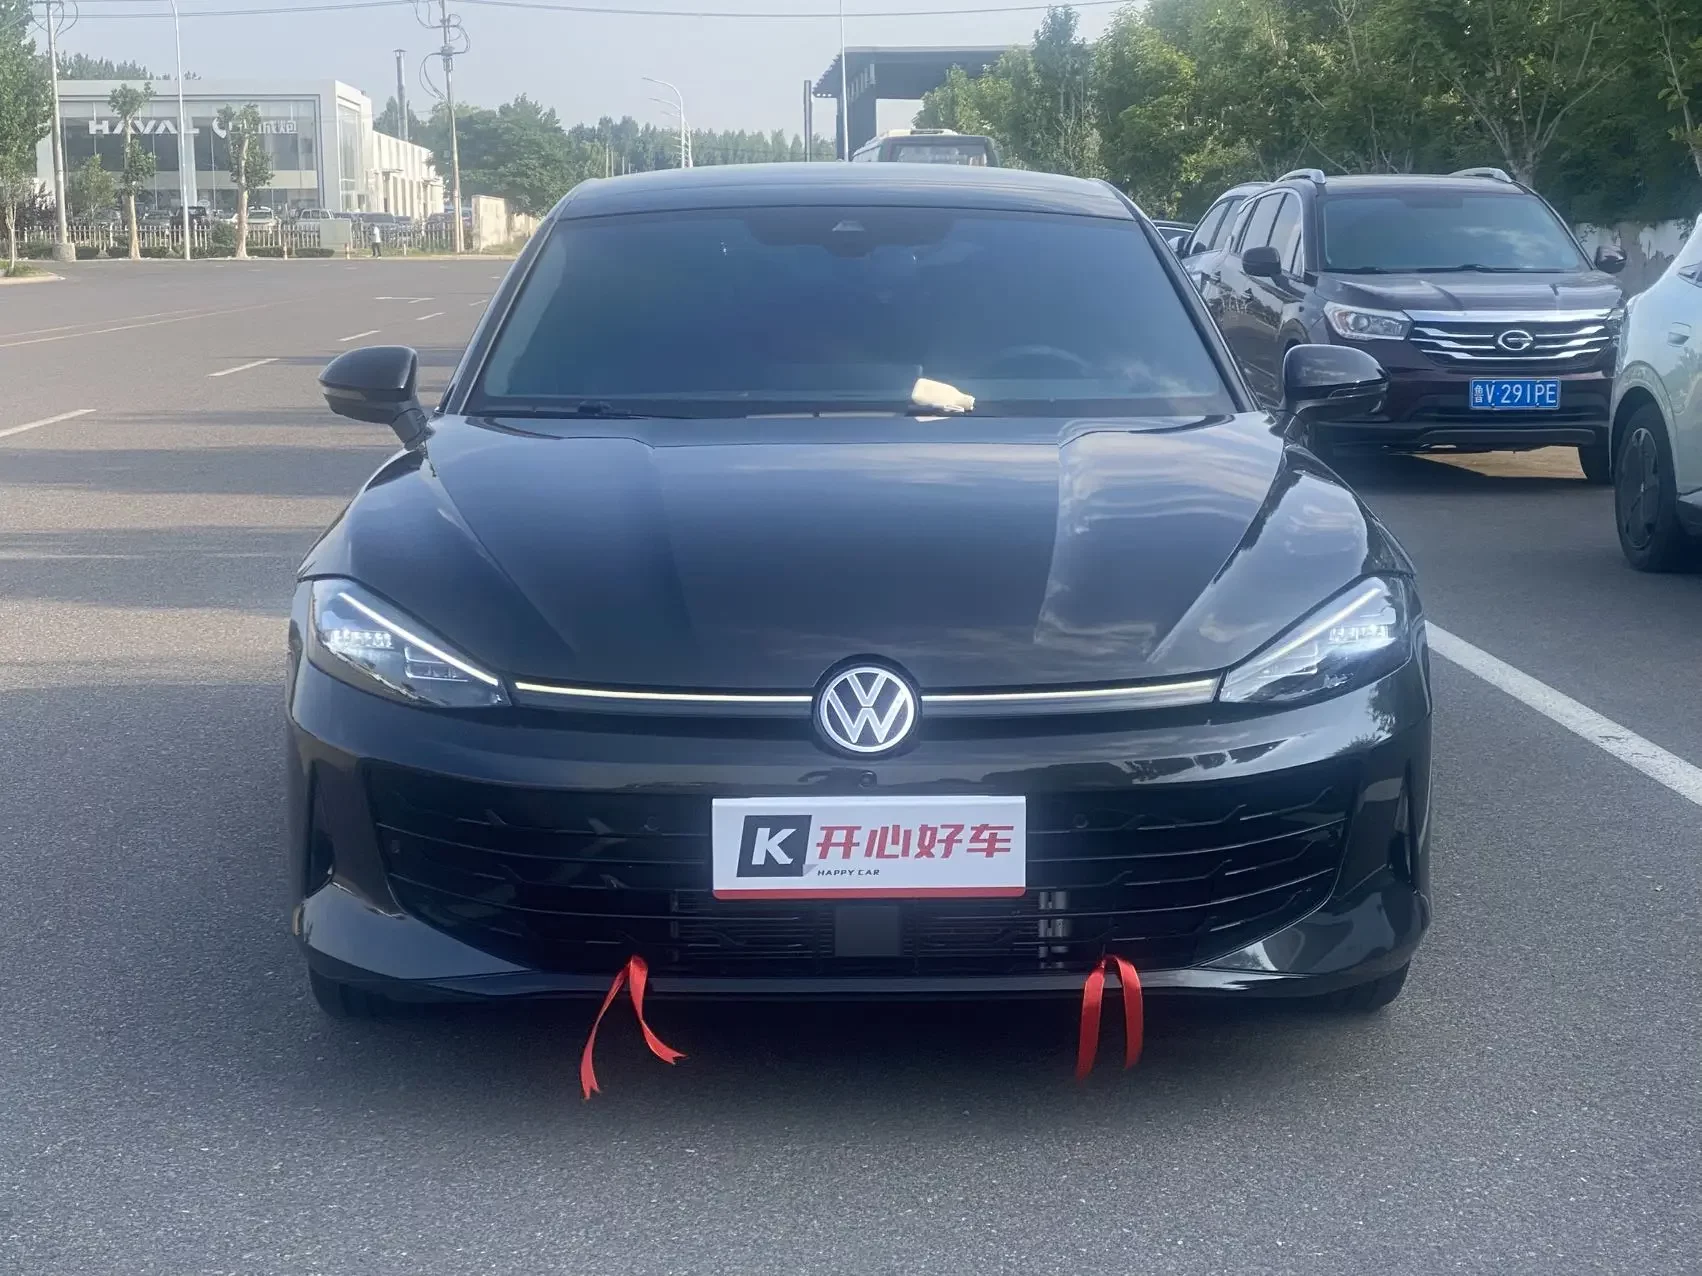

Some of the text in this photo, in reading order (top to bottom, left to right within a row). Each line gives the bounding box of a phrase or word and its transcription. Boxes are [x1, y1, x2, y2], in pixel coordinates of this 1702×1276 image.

[751, 827, 796, 865] K
[816, 823, 1014, 860] 开心好车
[817, 869, 854, 877] HAPPY
